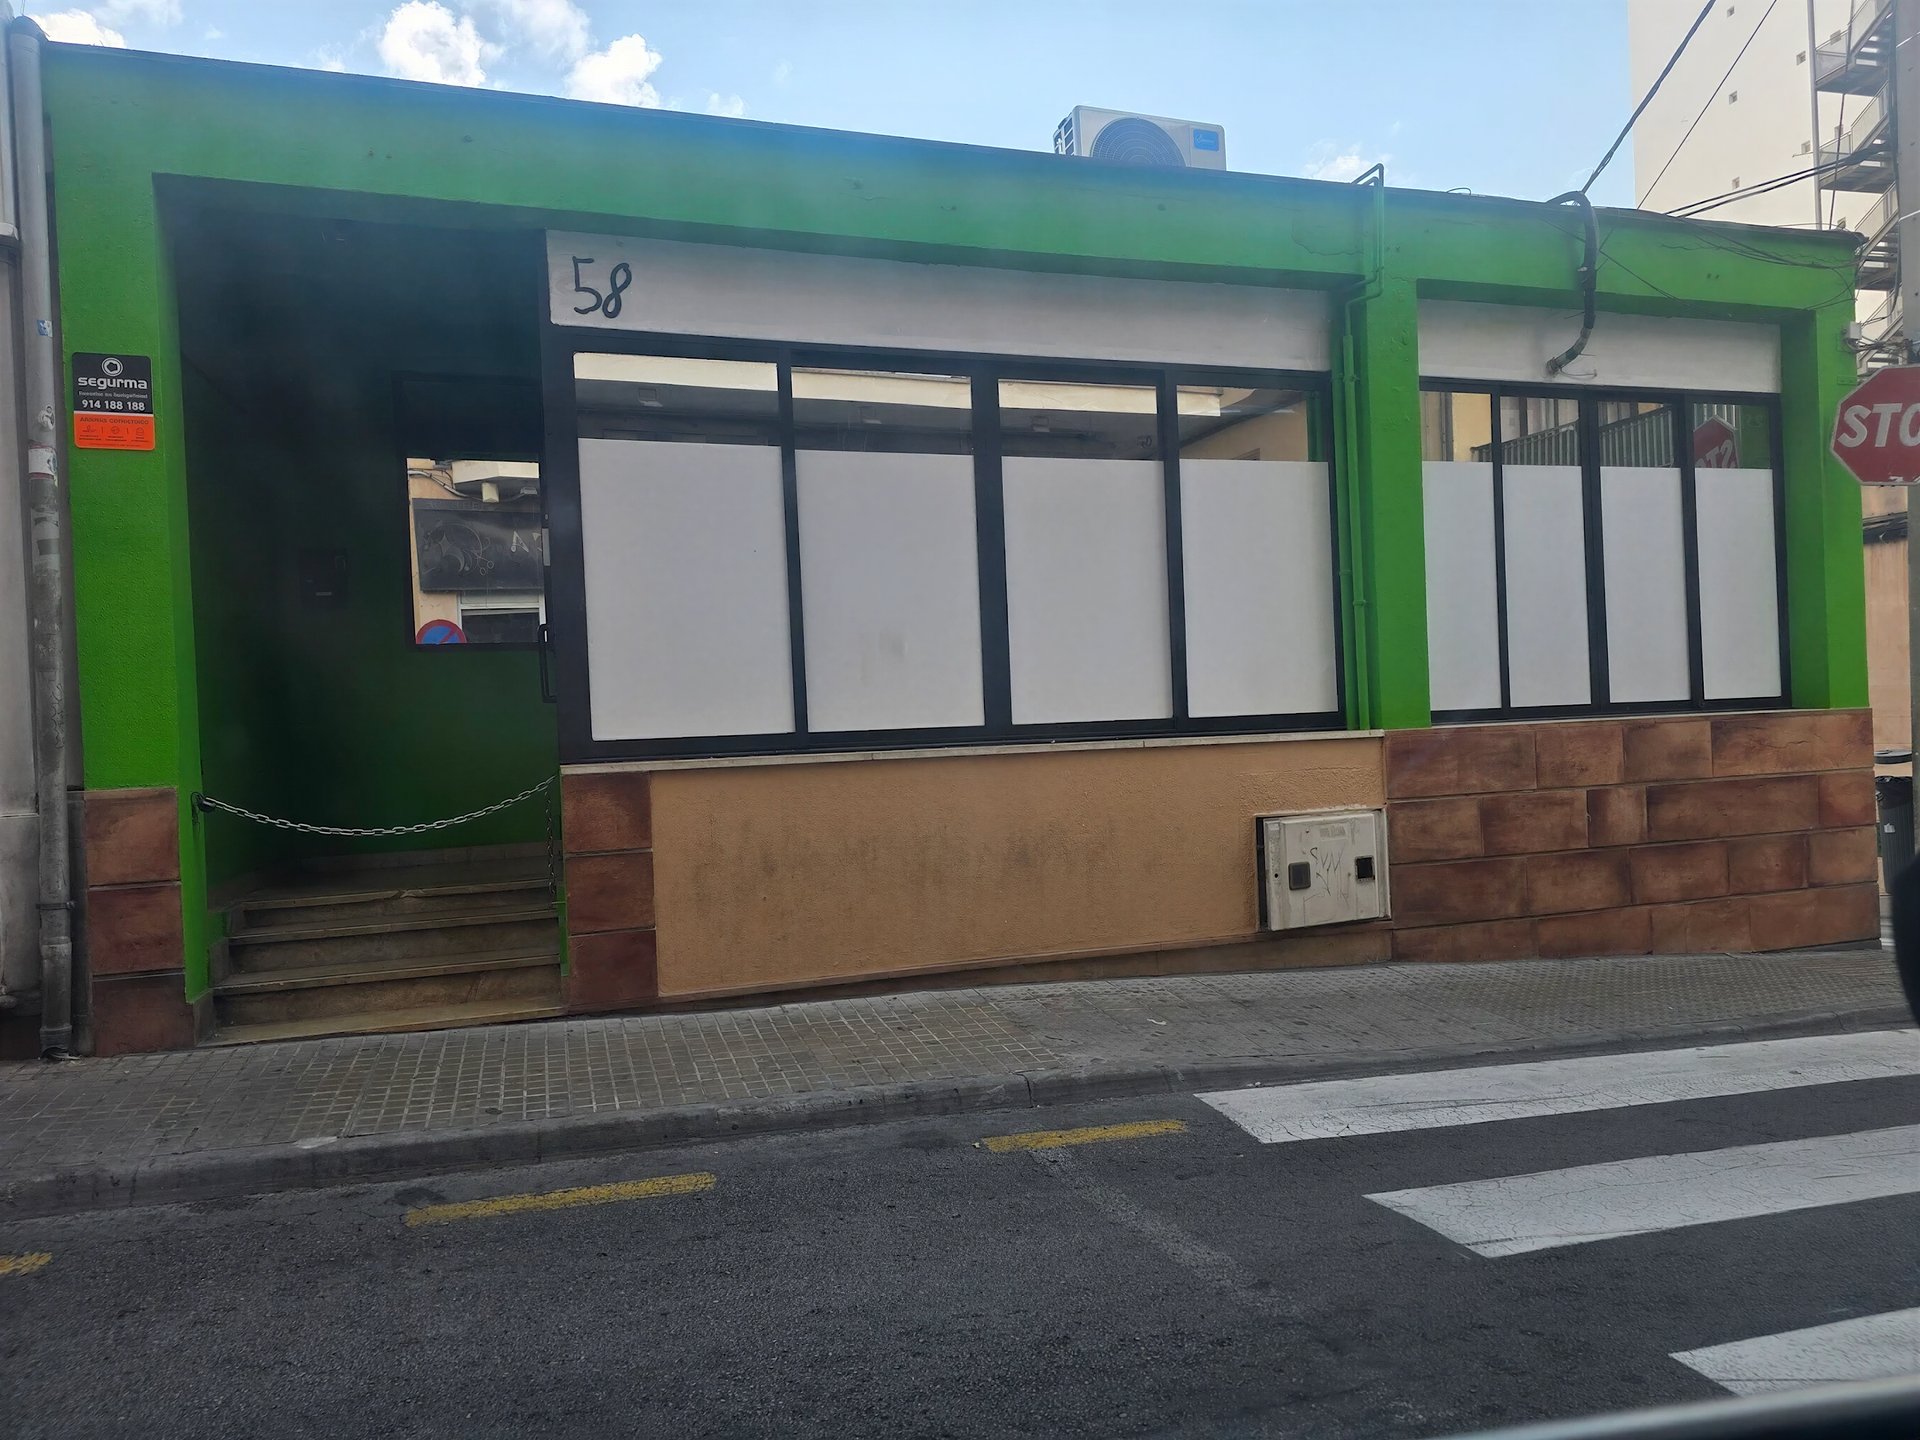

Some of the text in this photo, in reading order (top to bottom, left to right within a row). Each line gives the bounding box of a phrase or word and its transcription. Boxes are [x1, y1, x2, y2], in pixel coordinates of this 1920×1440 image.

[572, 255, 632, 319] 58
[78, 376, 148, 390] segurma
[82, 399, 145, 411] 914 188 188
